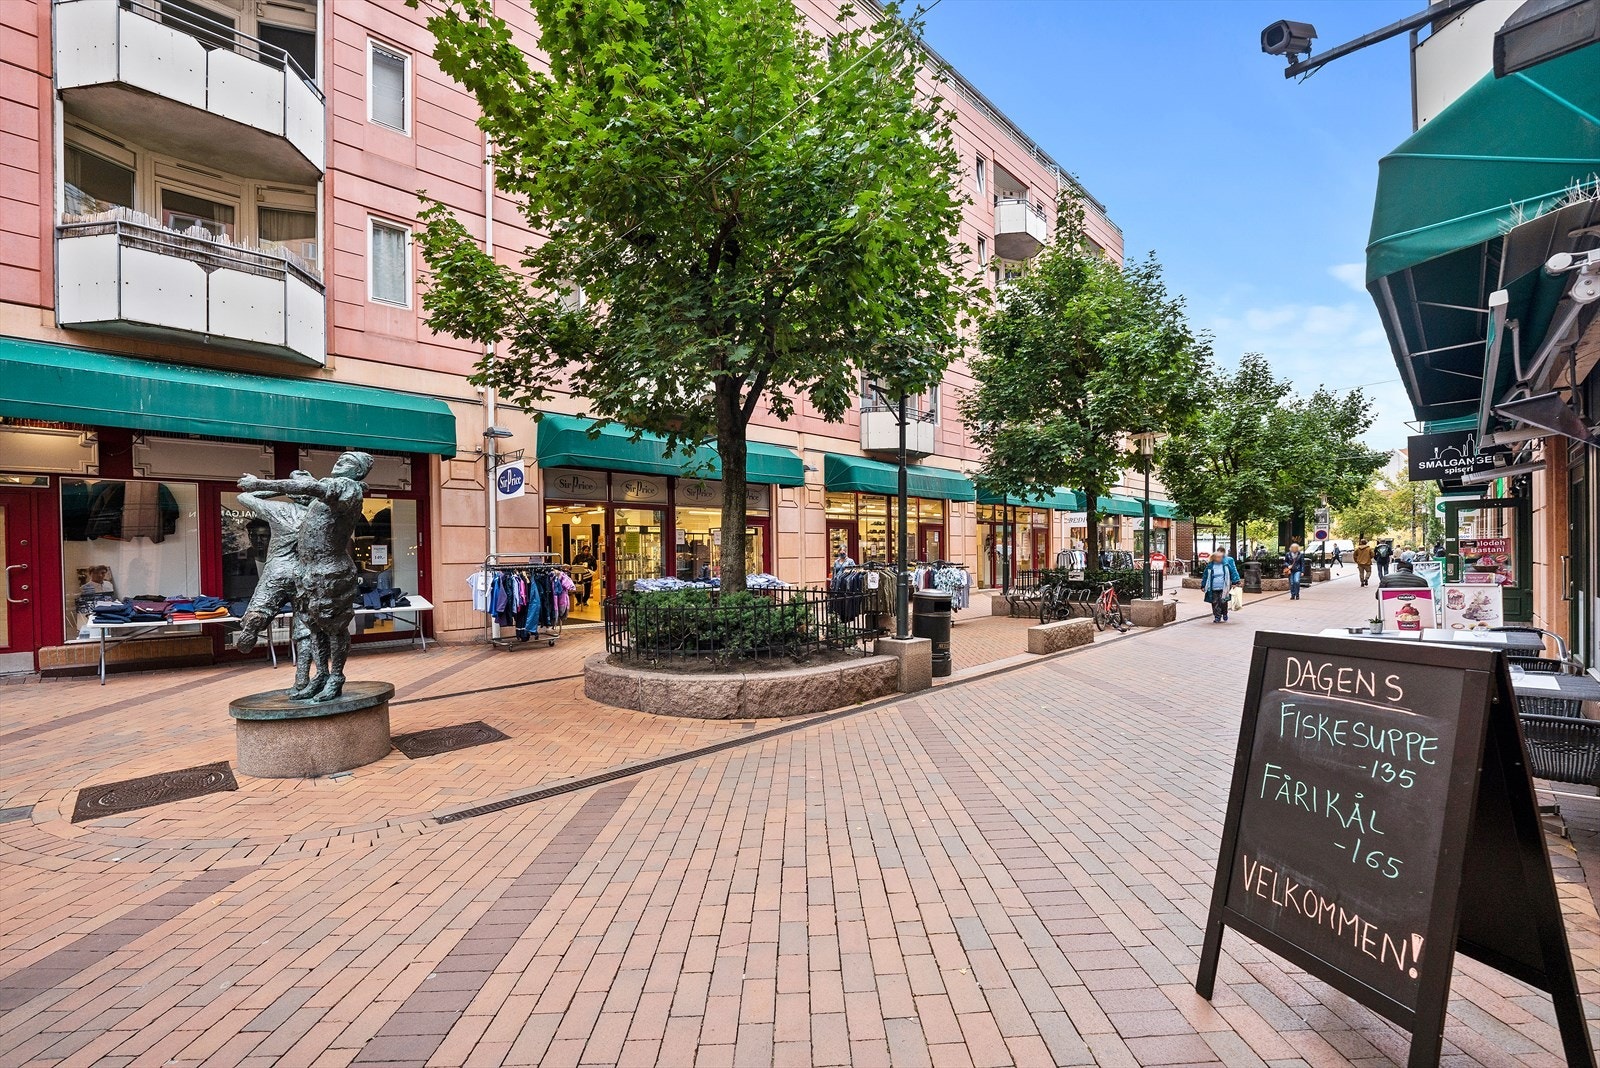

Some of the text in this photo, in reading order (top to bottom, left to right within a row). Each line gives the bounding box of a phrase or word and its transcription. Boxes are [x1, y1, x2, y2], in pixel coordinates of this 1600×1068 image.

[1444, 465, 1474, 475] spiseri
[1285, 656, 1404, 702] DAGENS
[1279, 702, 1439, 765] FISKESUPPE
[1260, 763, 1385, 835] FÅRIKÅL
[1358, 760, 1417, 789] -135
[1243, 854, 1425, 980] VELKOMMEN!
